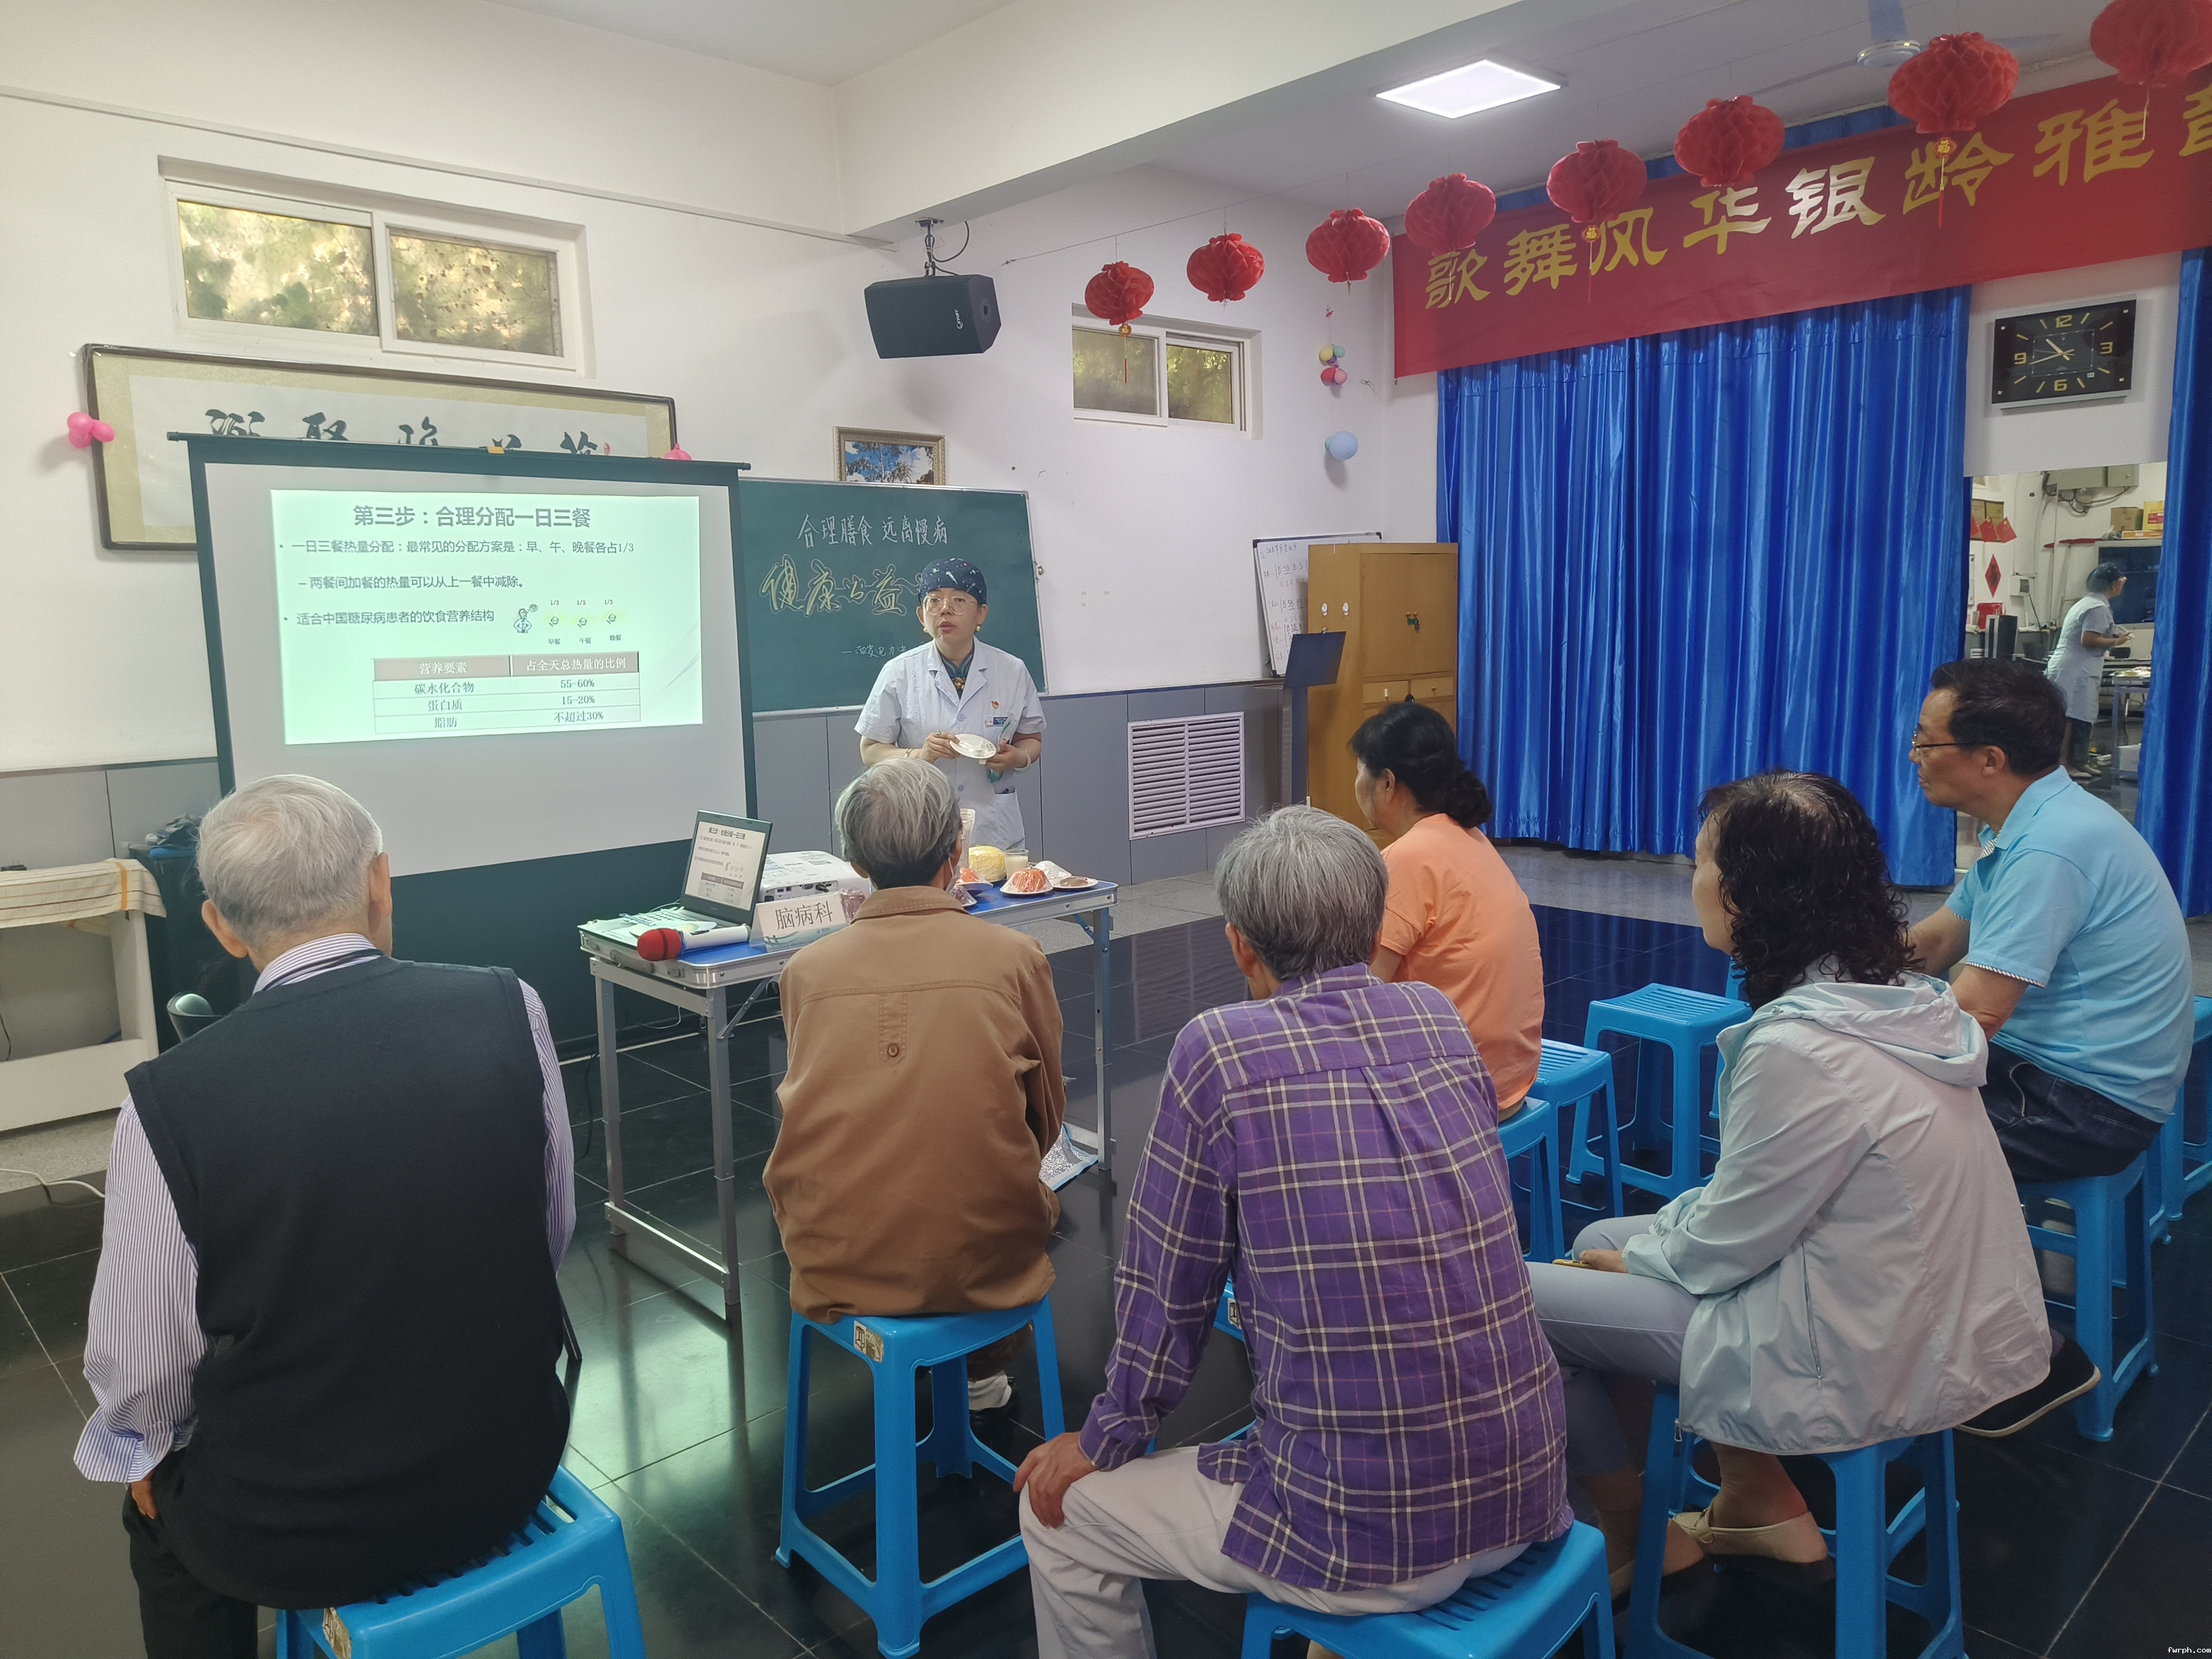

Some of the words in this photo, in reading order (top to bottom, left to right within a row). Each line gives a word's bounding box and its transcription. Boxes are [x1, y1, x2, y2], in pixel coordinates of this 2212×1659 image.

[2055, 314, 2072, 328] 12
[2100, 342, 2113, 355] 3
[2014, 352, 2027, 365] 9
[2054, 379, 2067, 392] 6
[354, 505, 591, 528] 第三步：合理分配一日三餐
[798, 513, 873, 549] 合理膳食
[882, 515, 948, 546] 远离慢病
[296, 610, 495, 625] 适合中国糖尿病患者的饮食营养结构
[419, 661, 468, 675] 营养要素
[527, 657, 626, 672] 占全天总热量的比例
[414, 681, 474, 695] 碳水化合物
[561, 678, 595, 689] 55-60%
[427, 698, 463, 712] 蛋白质
[562, 695, 596, 705] 15-20%
[434, 716, 458, 729] 脂肪
[554, 710, 604, 724] 不超过30%
[775, 900, 833, 930] 脑病科
